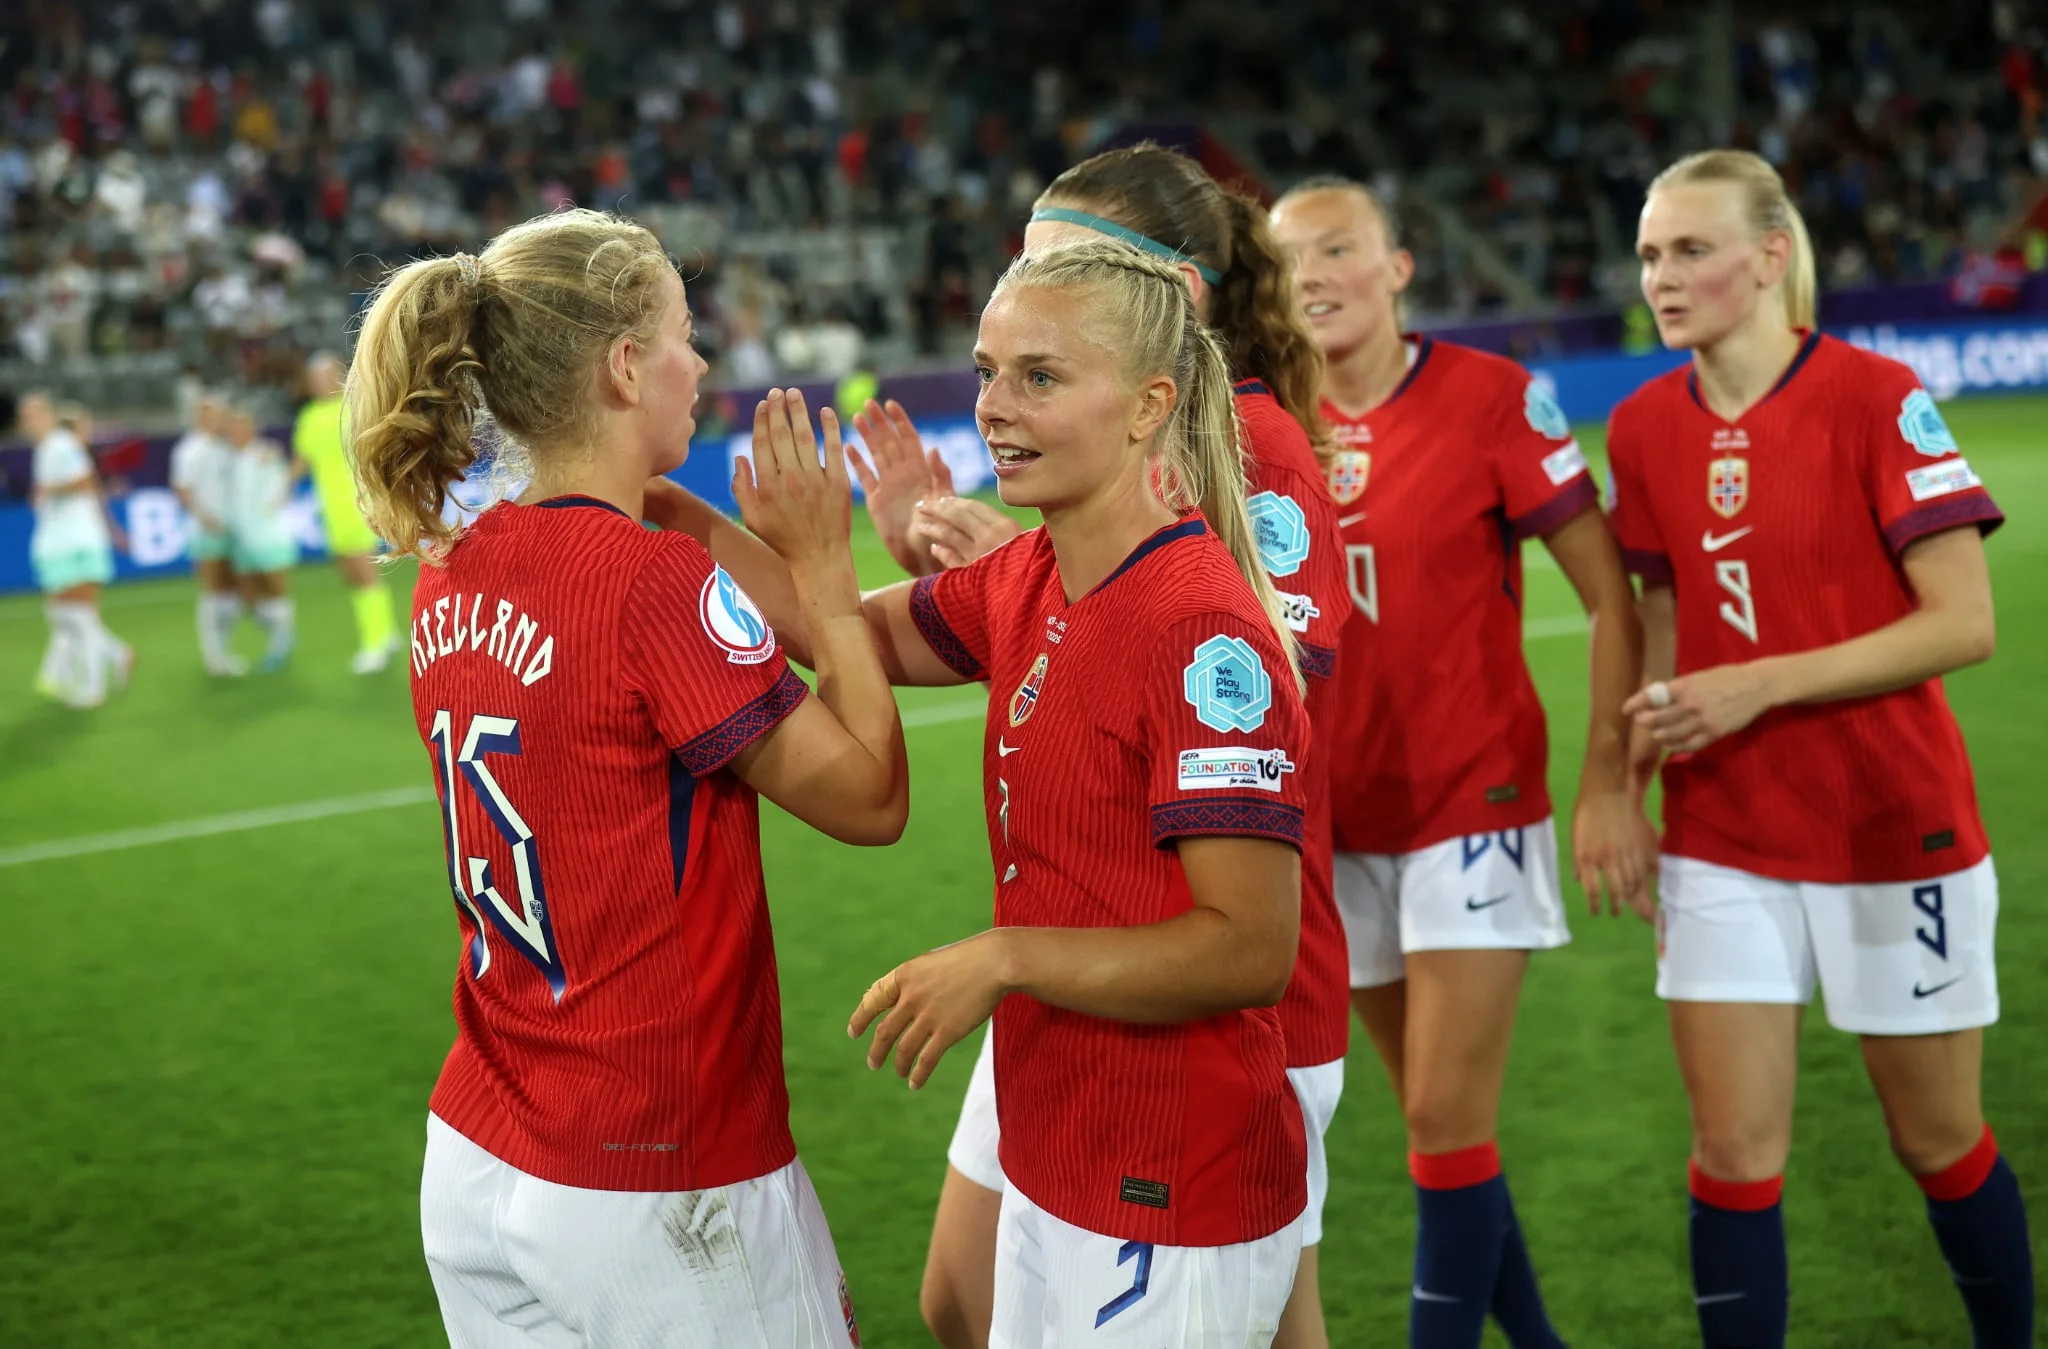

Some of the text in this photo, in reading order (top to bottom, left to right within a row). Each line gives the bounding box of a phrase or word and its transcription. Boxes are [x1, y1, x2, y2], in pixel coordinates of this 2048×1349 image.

[1714, 560, 1759, 645] 9
[1215, 666, 1233, 676] We
[1215, 677, 1240, 690] Play
[1216, 688, 1251, 704] Strong
[1181, 752, 1200, 761] UEFA
[1180, 762, 1257, 775] FOUNDATION
[1257, 758, 1280, 780] 10
[429, 708, 567, 1007] 15
[1912, 884, 1946, 962] 9
